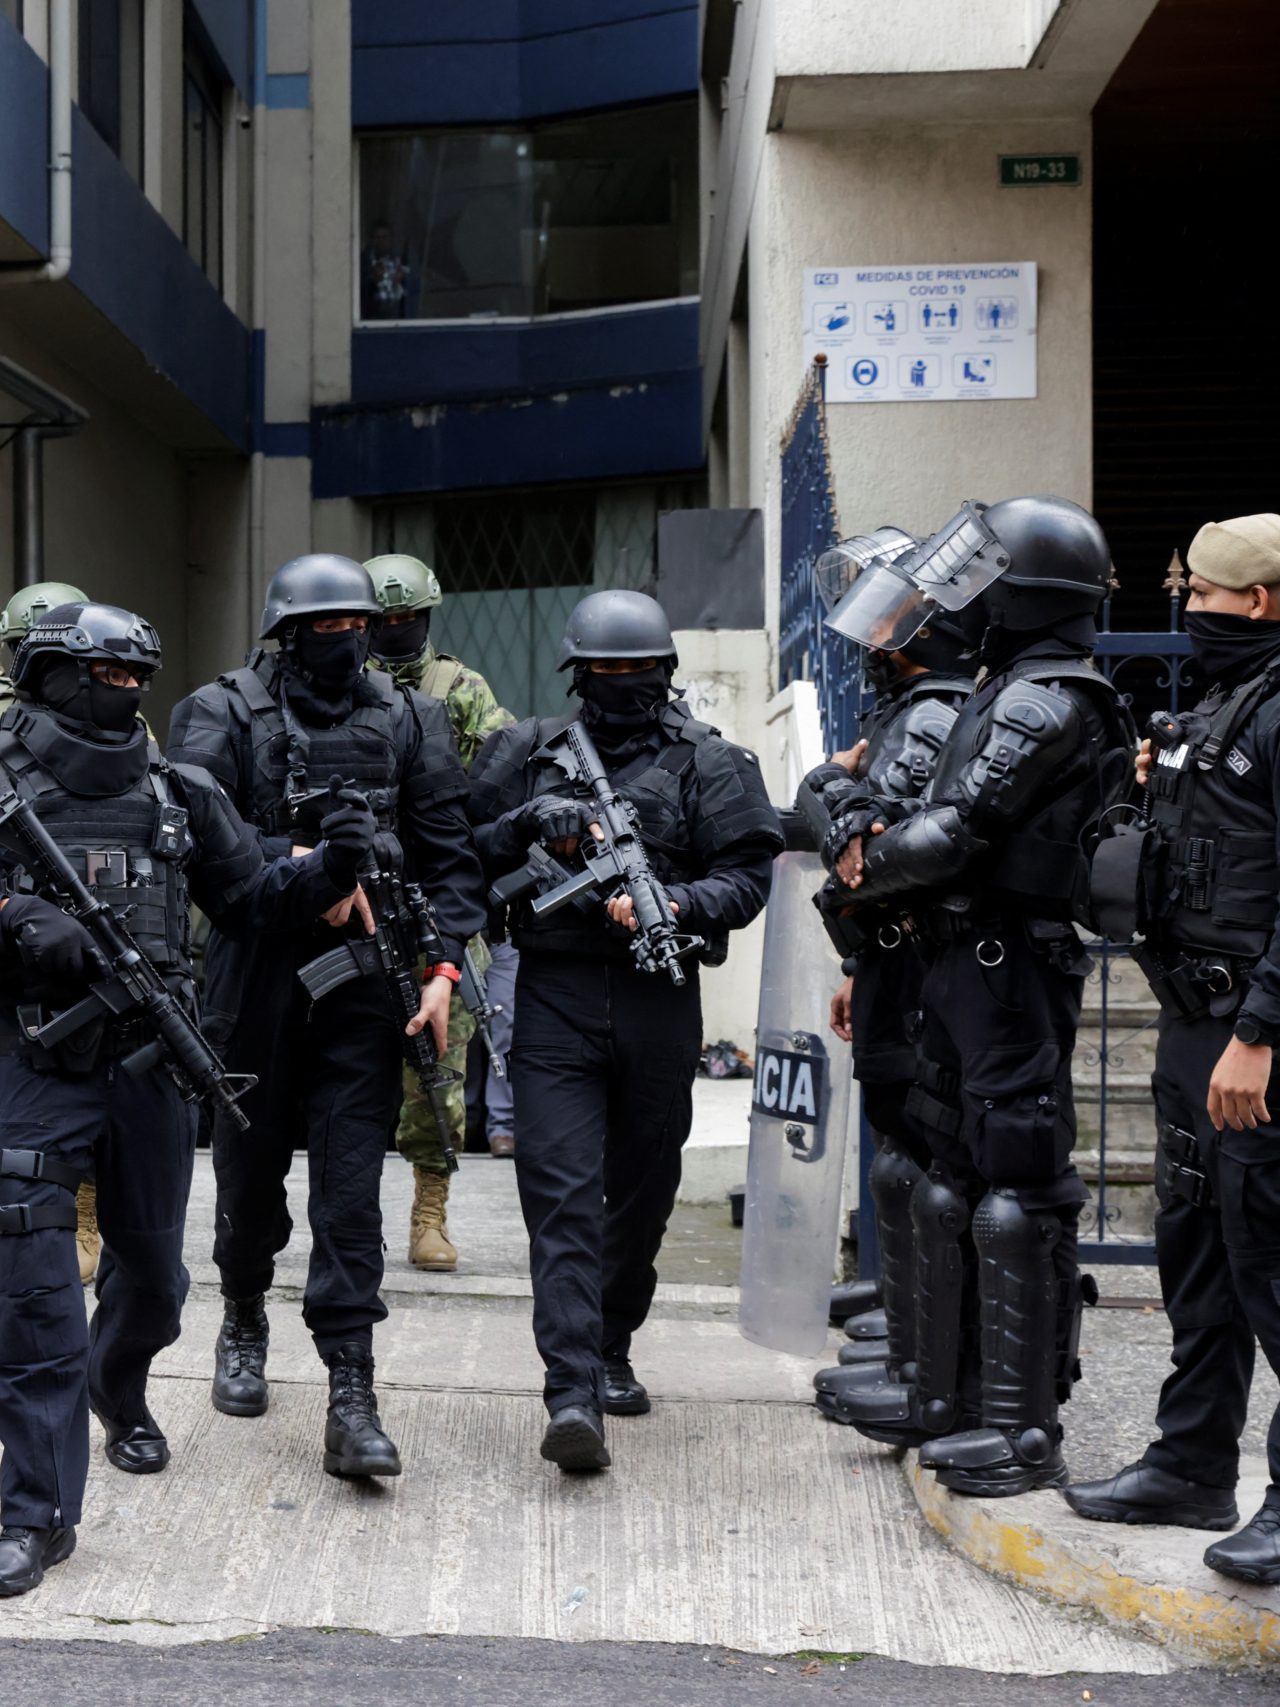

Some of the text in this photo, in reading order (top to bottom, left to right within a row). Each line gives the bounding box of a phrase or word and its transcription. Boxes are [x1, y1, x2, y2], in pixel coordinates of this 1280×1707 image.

[1013, 162, 1066, 178] N19-33
[856, 267, 1020, 283] MEDIDAS DE PREVENCIÓN
[908, 284, 967, 296] COVID 19
[753, 1052, 816, 1117] ICIA
